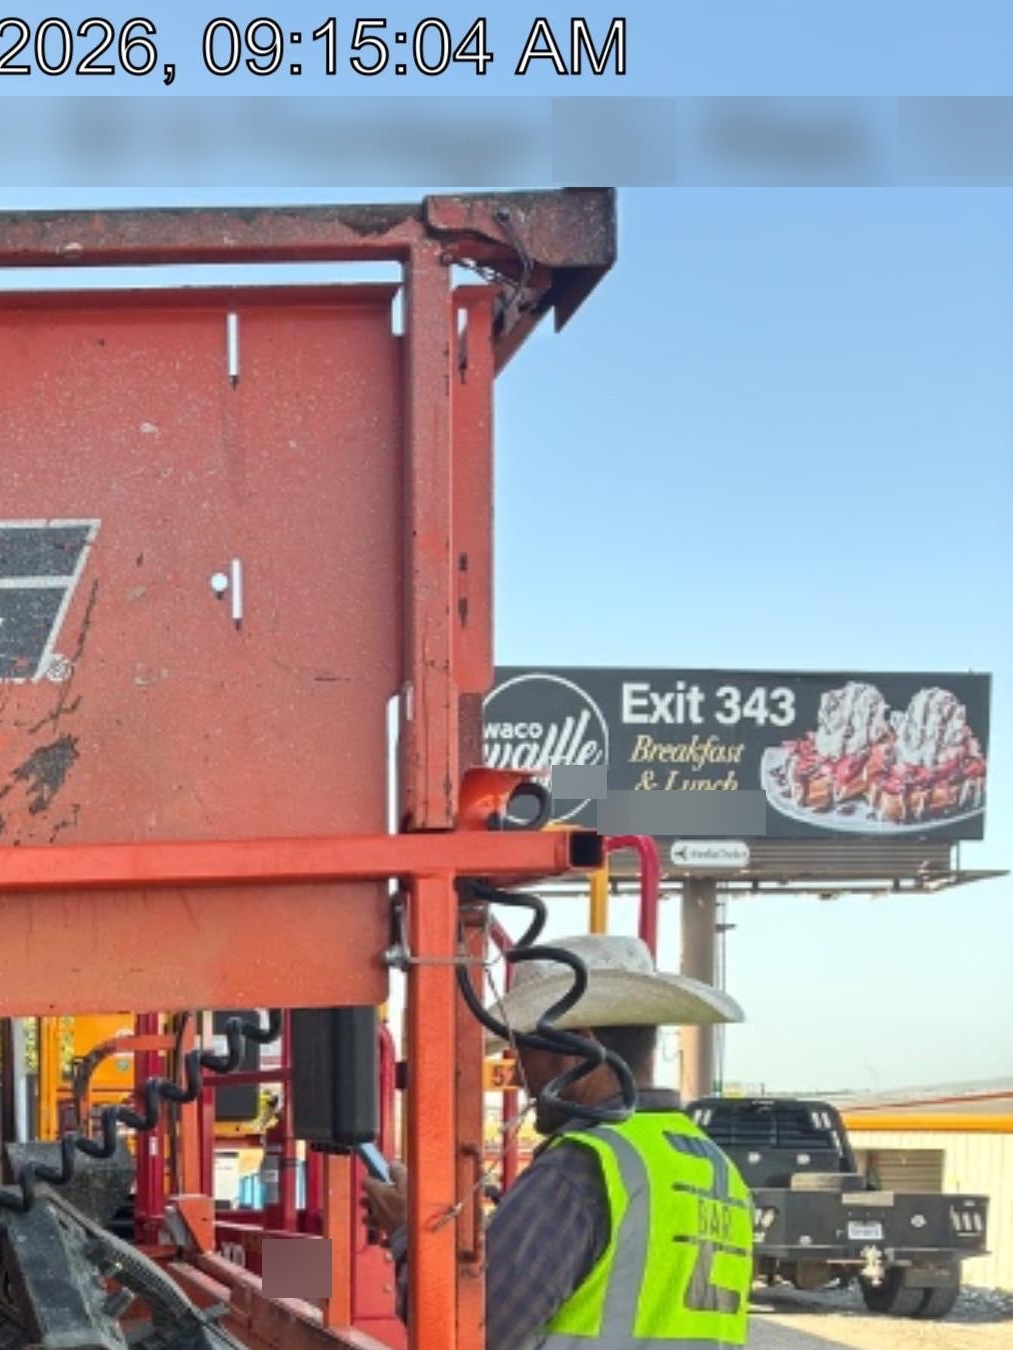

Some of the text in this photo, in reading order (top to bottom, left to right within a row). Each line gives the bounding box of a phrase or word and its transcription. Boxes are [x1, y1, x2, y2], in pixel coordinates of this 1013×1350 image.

[622, 680, 796, 727] Exit 343
[628, 734, 745, 772] Breakfast
